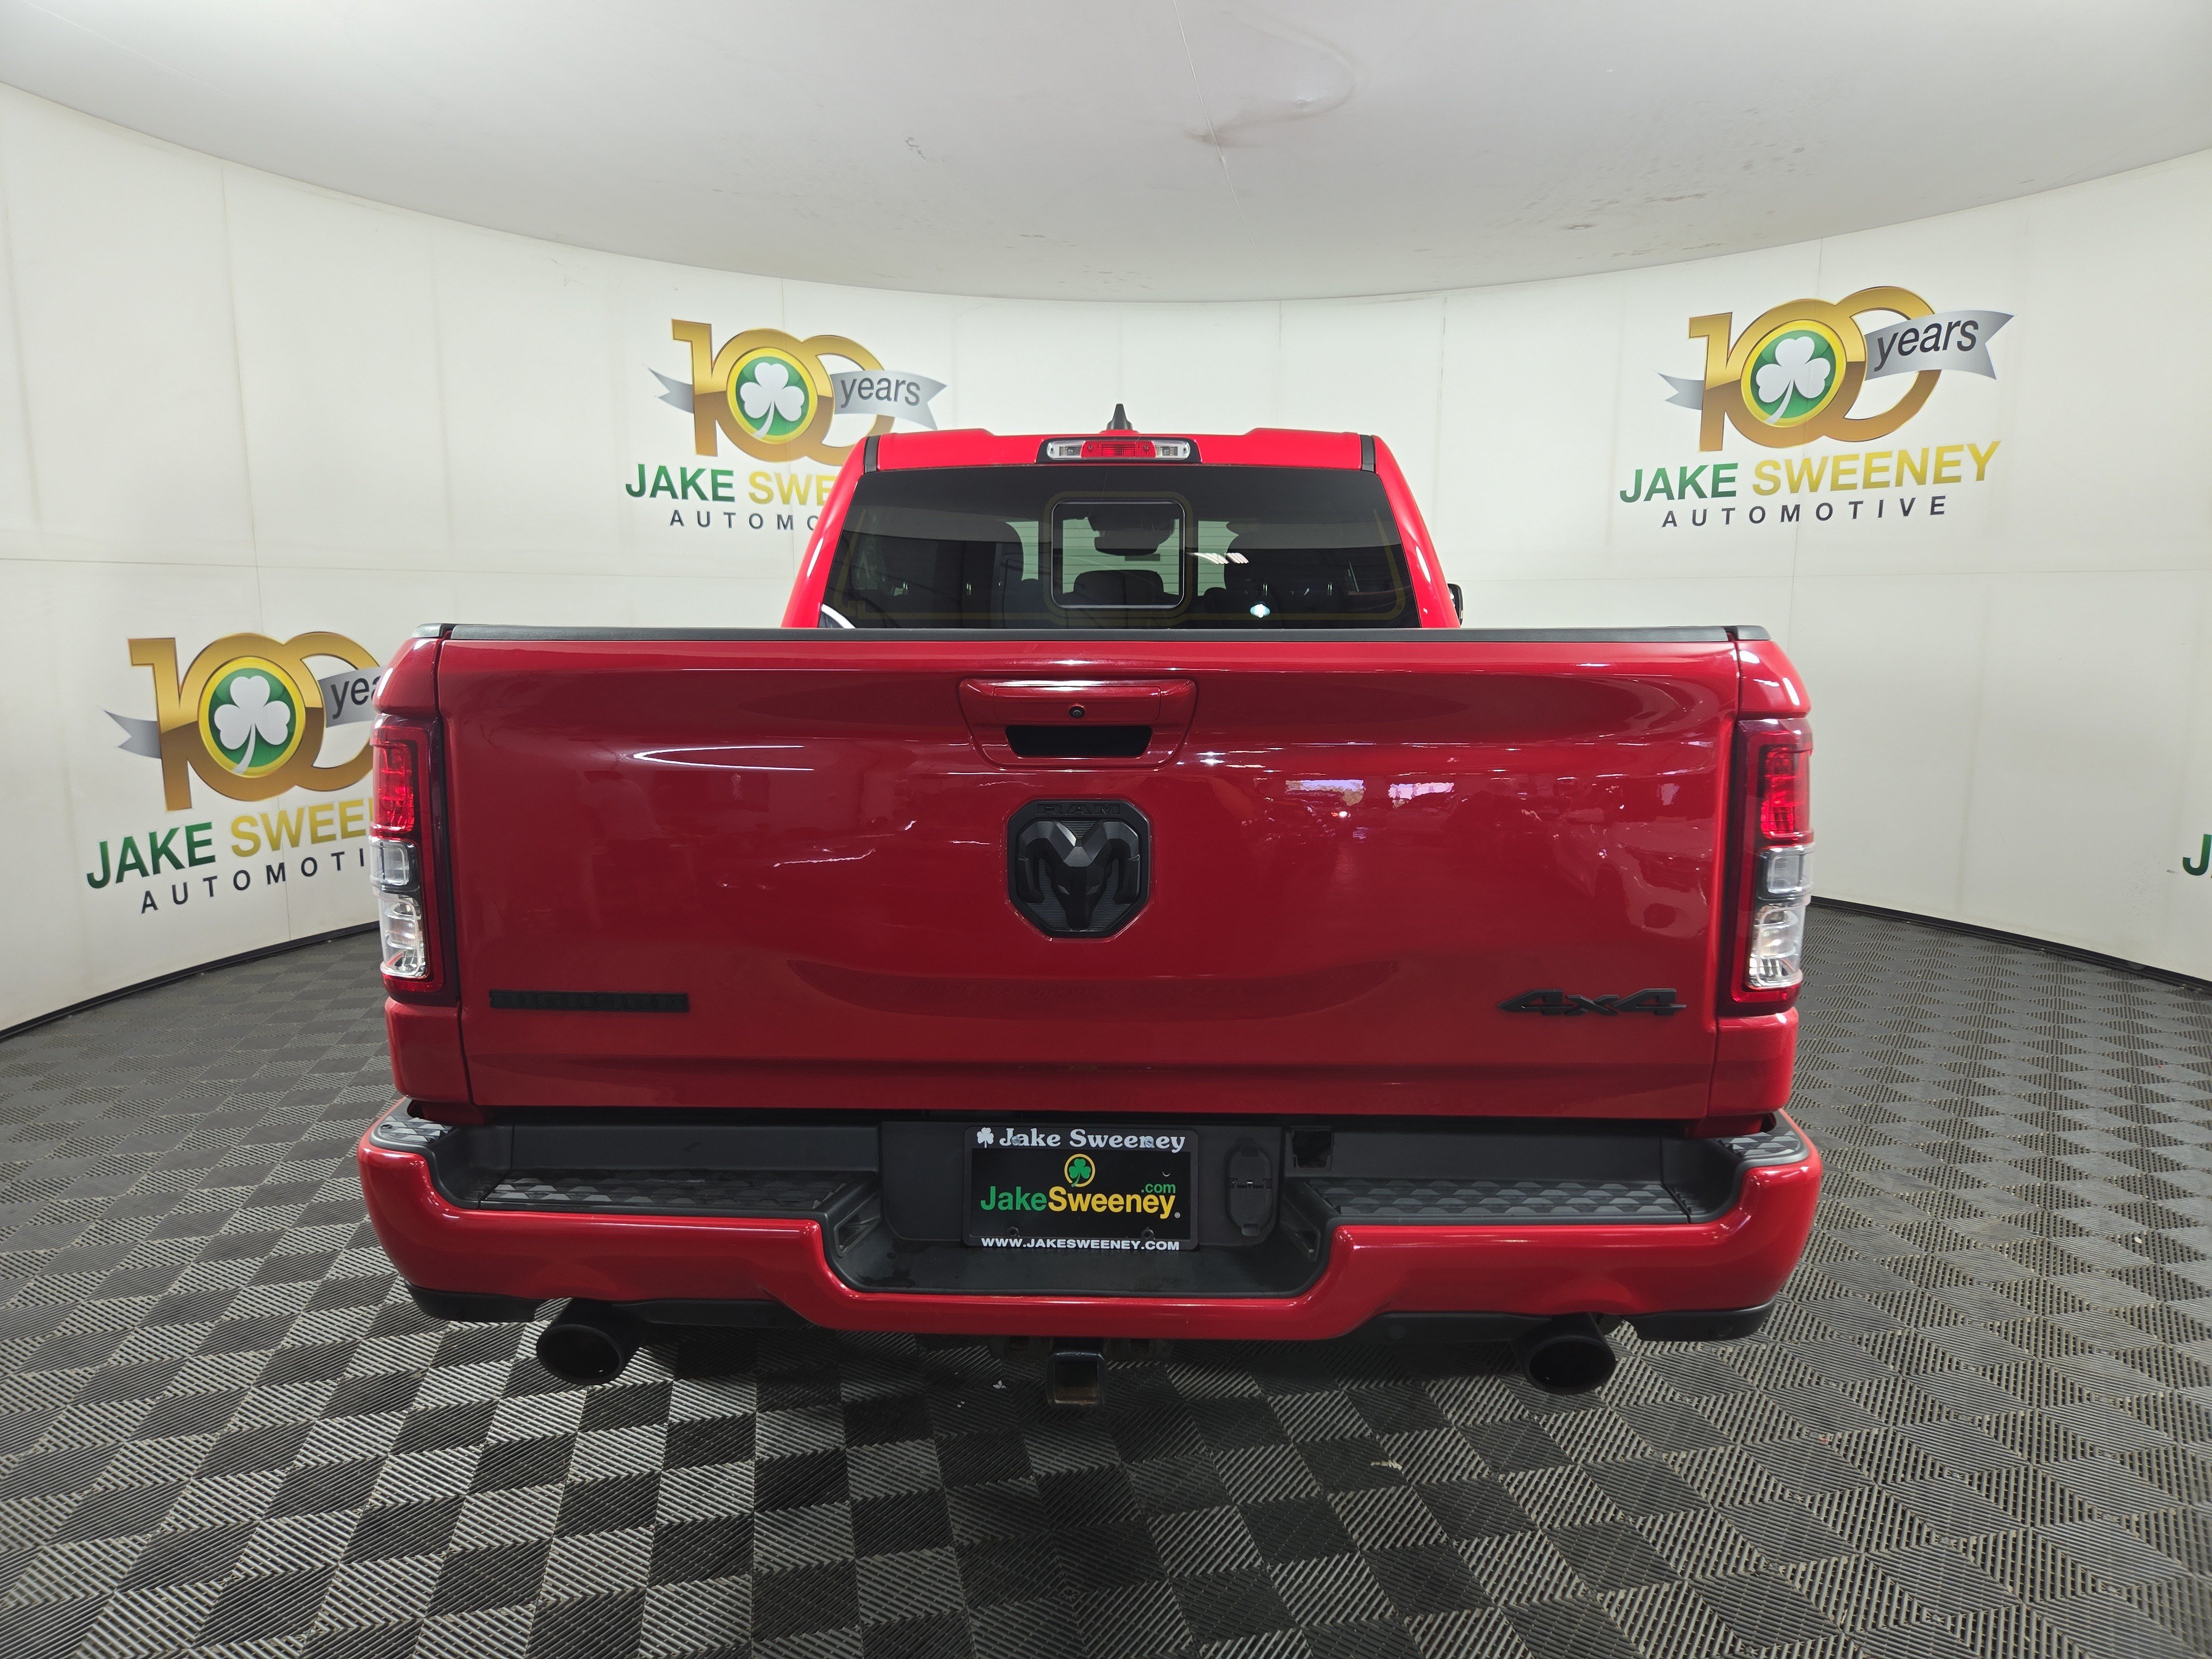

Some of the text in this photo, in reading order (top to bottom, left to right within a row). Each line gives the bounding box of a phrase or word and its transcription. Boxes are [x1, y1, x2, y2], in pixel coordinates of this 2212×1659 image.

[1873, 318, 1978, 372] years
[840, 377, 921, 408] years
[625, 464, 735, 502] JAKE
[1619, 441, 2001, 503] JAKE SWEENEY
[1662, 496, 1946, 528] AUTOMOTIVE
[1037, 803, 1121, 815] RAM
[86, 798, 373, 889] JAKE SWEE
[142, 848, 364, 914] AUTOMOTI
[1000, 1128, 1186, 1153] Jake Sweeney
[1141, 1183, 1176, 1193] .com
[981, 1238, 1180, 1250] WWW.JAKESWEENEY.COM
